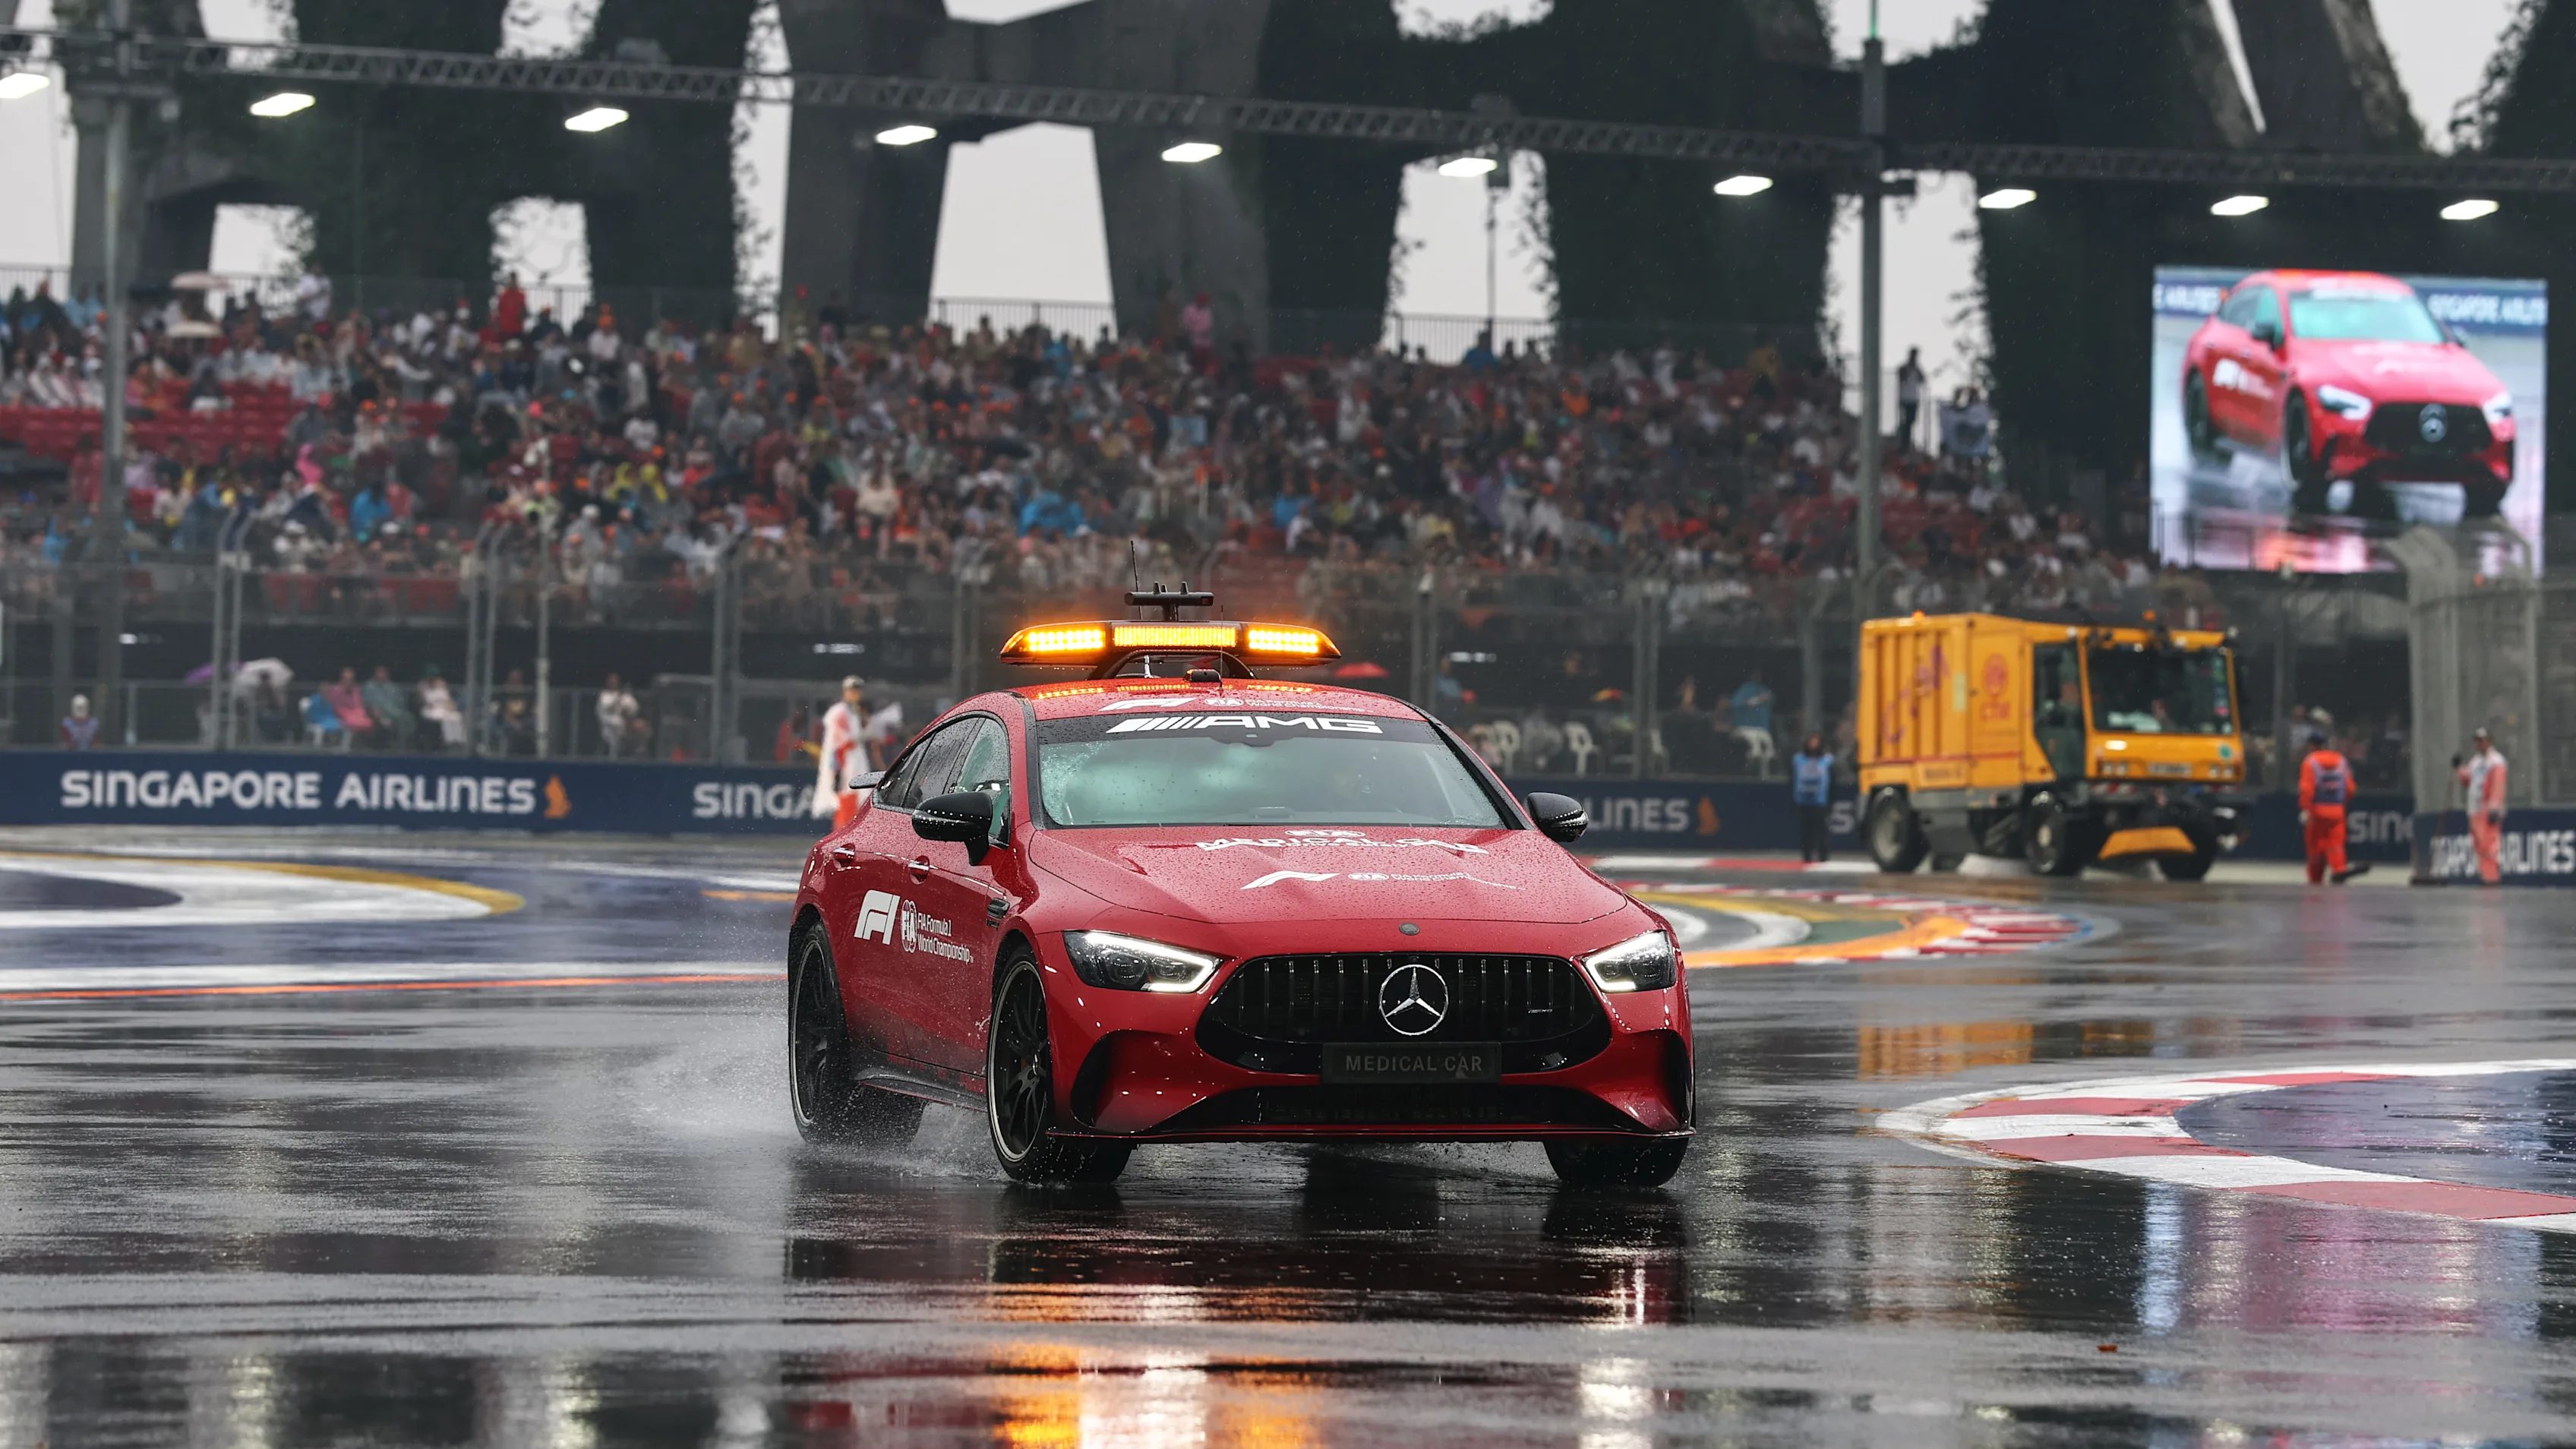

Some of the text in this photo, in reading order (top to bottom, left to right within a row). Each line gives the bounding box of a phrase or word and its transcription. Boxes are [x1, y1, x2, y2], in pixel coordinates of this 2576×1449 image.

[61, 770, 536, 813] SINGAPORE AIRLINES
[917, 912, 927, 931] FIA
[927, 914, 949, 936] Formula
[917, 933, 971, 964] World Championship
[1346, 1055, 1482, 1072] MEDICAL CAR
